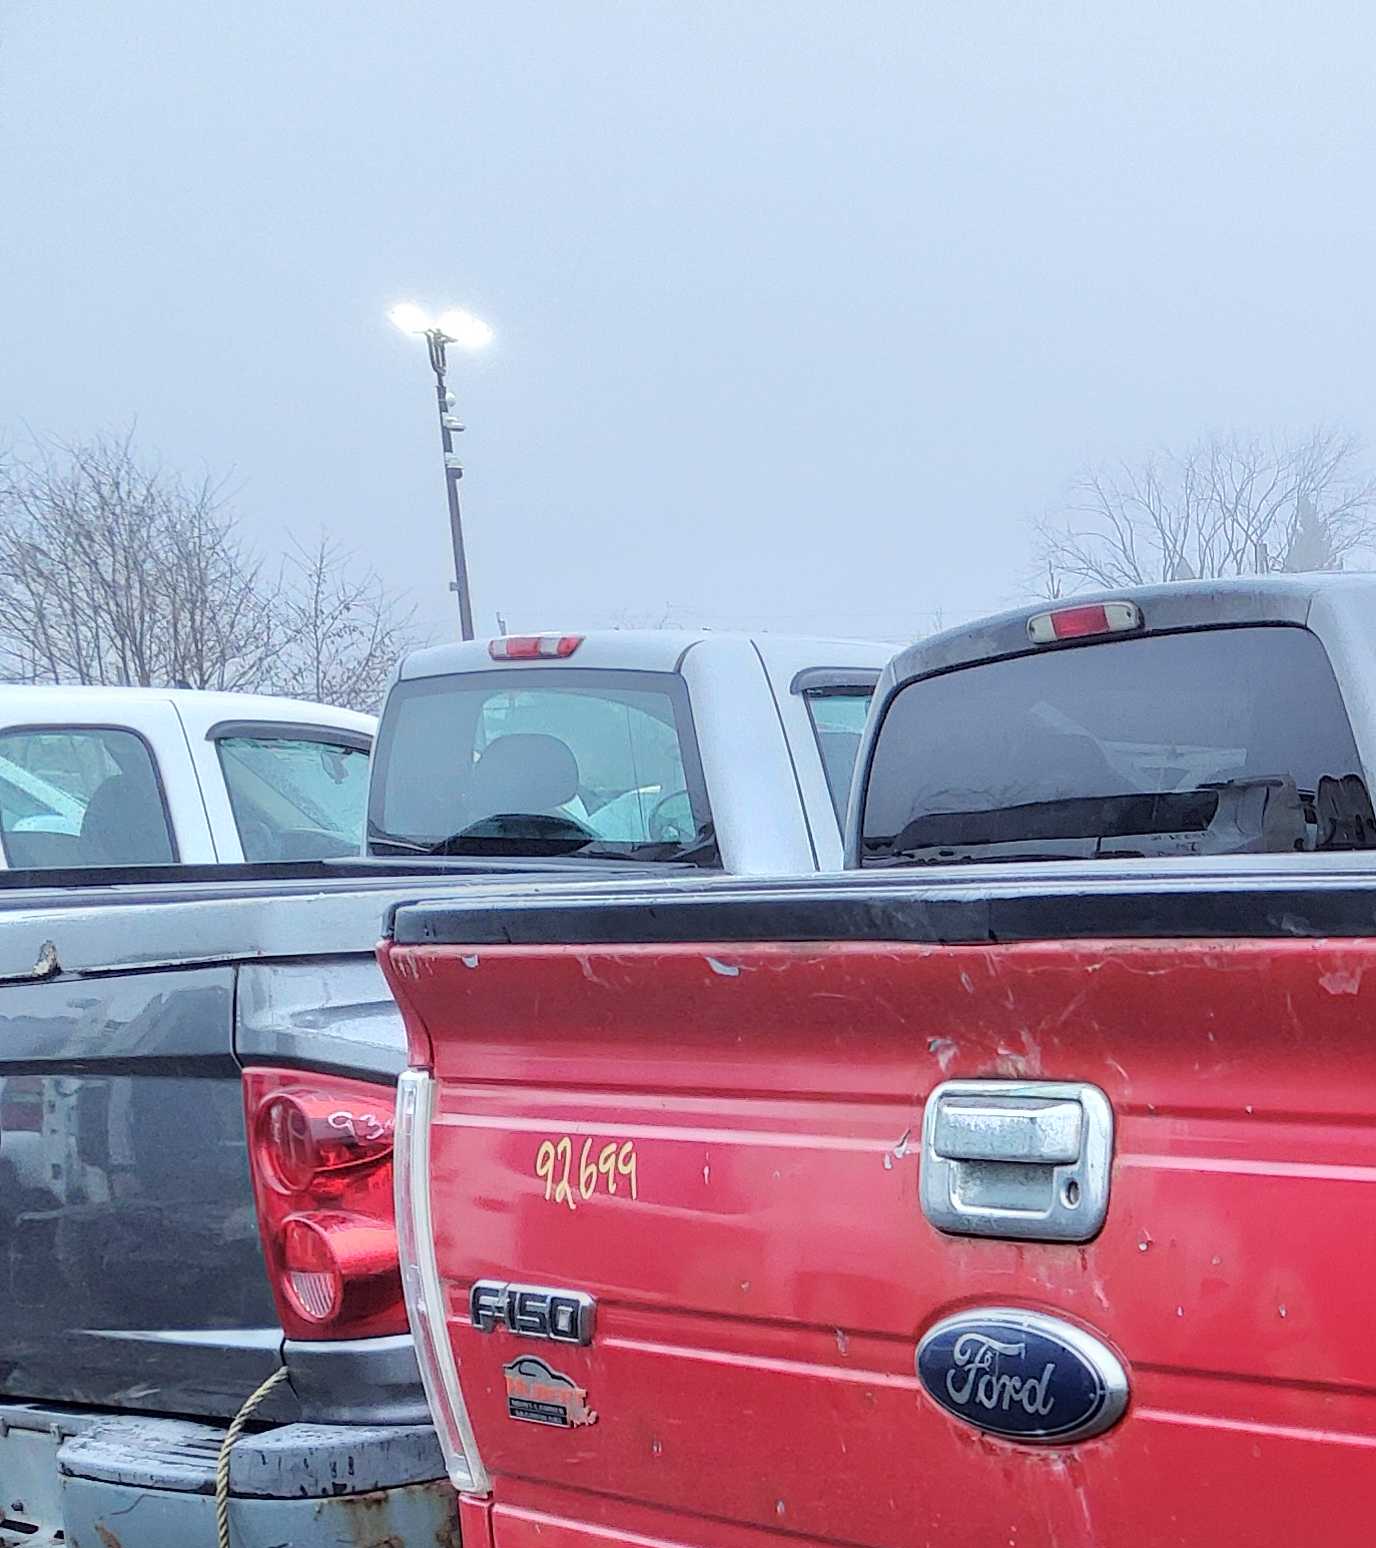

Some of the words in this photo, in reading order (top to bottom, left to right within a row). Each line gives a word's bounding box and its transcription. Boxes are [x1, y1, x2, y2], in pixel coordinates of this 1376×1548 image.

[535, 1136, 638, 1210] 92699
[470, 1280, 594, 1345] F-150
[946, 1332, 1056, 1416] Ford
